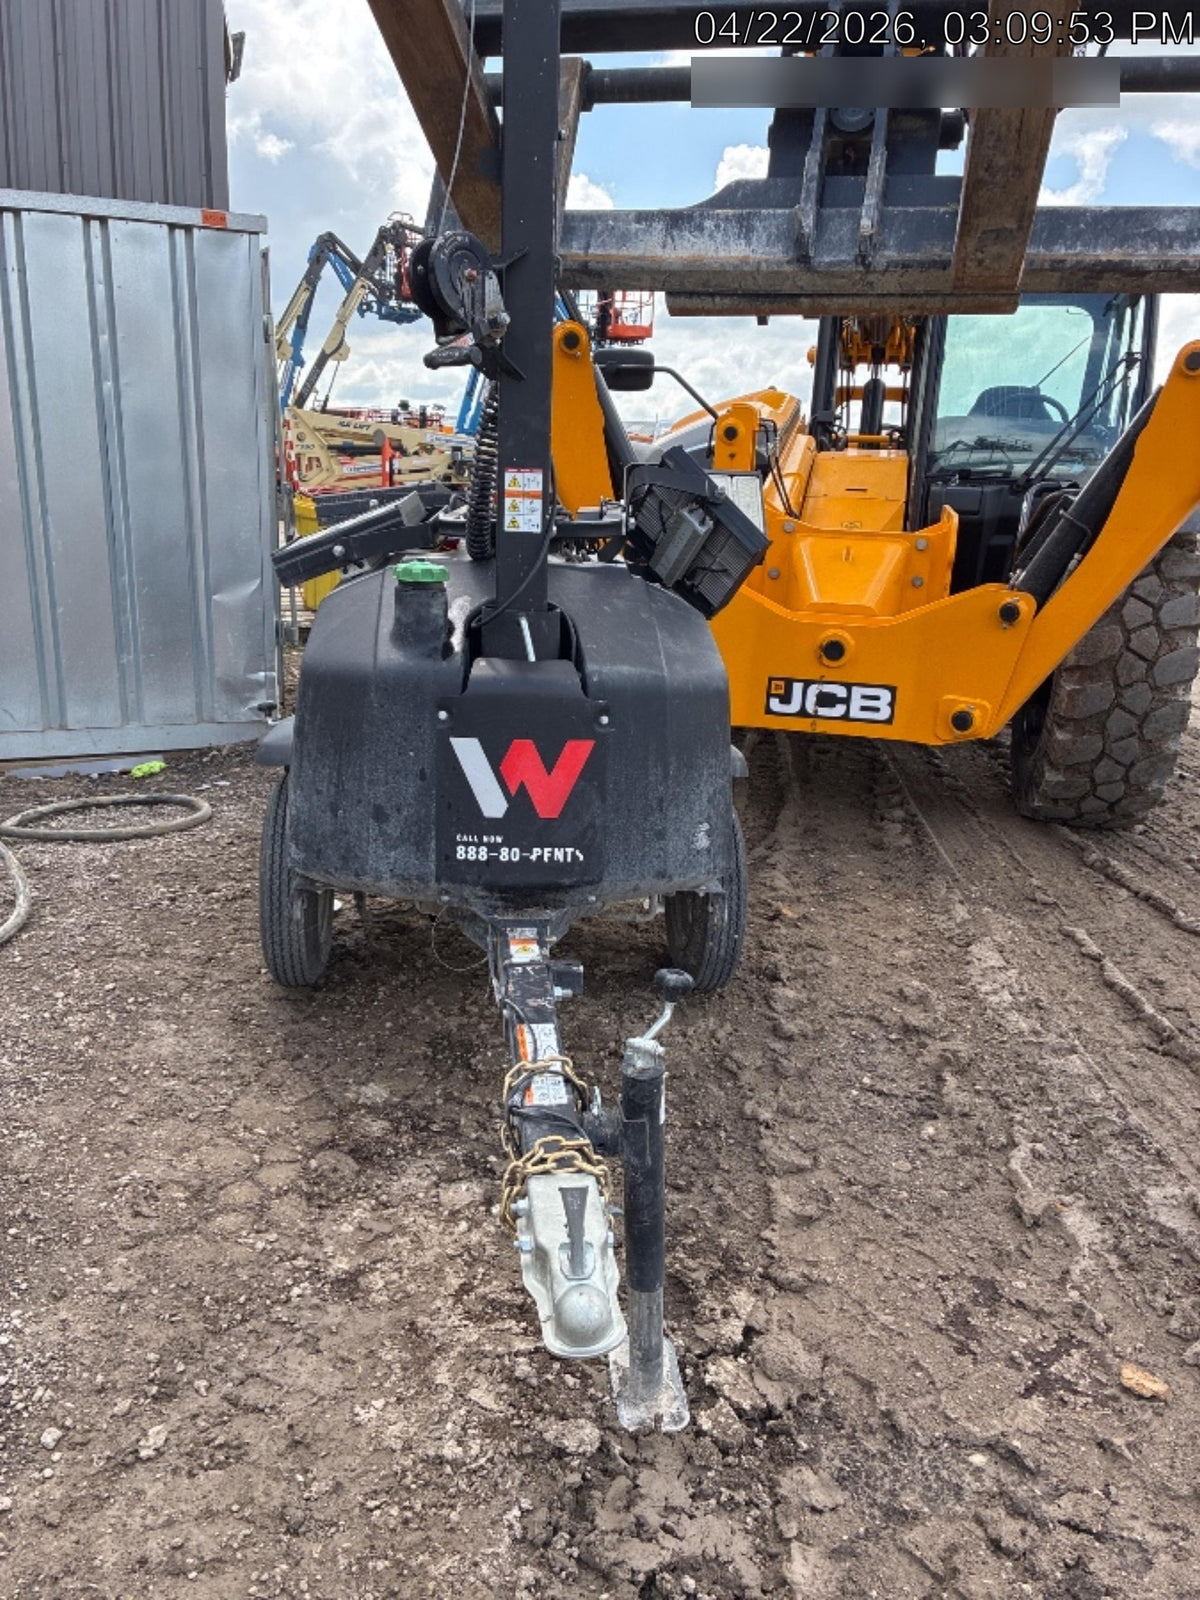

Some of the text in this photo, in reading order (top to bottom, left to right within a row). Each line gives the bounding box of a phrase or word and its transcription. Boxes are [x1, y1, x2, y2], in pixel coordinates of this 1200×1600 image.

[769, 682, 892, 721] JCB
[456, 833, 504, 844] CALL NOW
